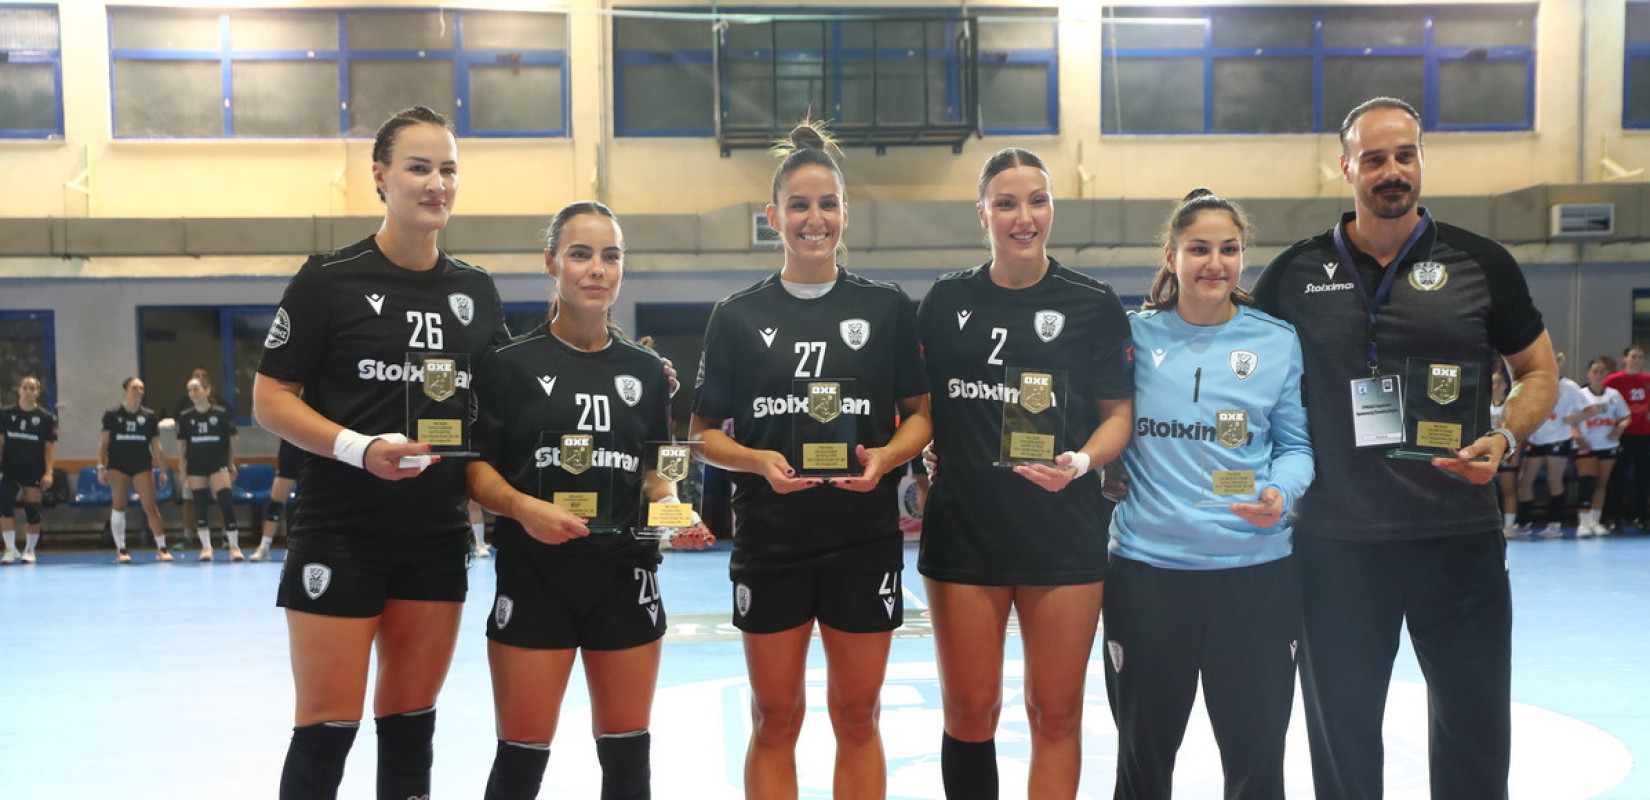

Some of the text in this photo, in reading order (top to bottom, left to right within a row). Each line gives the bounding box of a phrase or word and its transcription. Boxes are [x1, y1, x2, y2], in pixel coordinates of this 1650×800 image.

[406, 310, 444, 350] 26
[987, 327, 1008, 365] 2
[794, 341, 827, 378] 27
[1193, 367, 1202, 403] 1
[575, 392, 612, 432] 20
[752, 394, 870, 419] Stoixan
